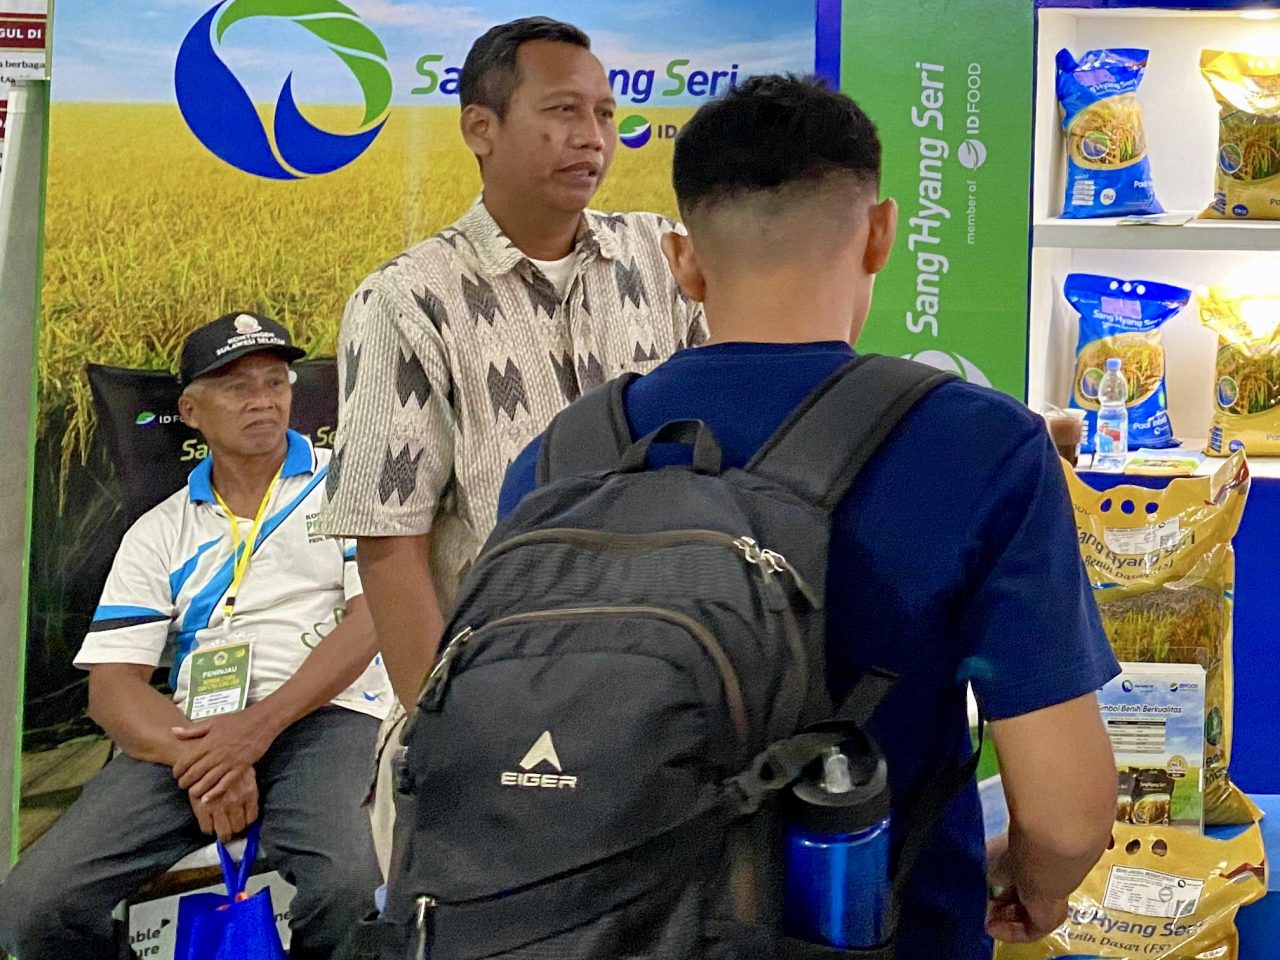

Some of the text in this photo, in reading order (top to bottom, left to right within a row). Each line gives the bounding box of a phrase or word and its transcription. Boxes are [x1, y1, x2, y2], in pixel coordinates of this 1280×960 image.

[28, 29, 41, 39] DI
[411, 54, 462, 95] Sa
[662, 59, 739, 98] Seri
[658, 124, 677, 140] ID
[967, 63, 981, 245] member of ID FOOD
[906, 62, 950, 337] Sang Hyang Seri
[180, 439, 208, 461] Sa
[1078, 527, 1104, 555] ang
[1142, 705, 1182, 714] Berkualitas
[501, 771, 577, 789] EIGER
[1100, 937, 1139, 951] Dasar
